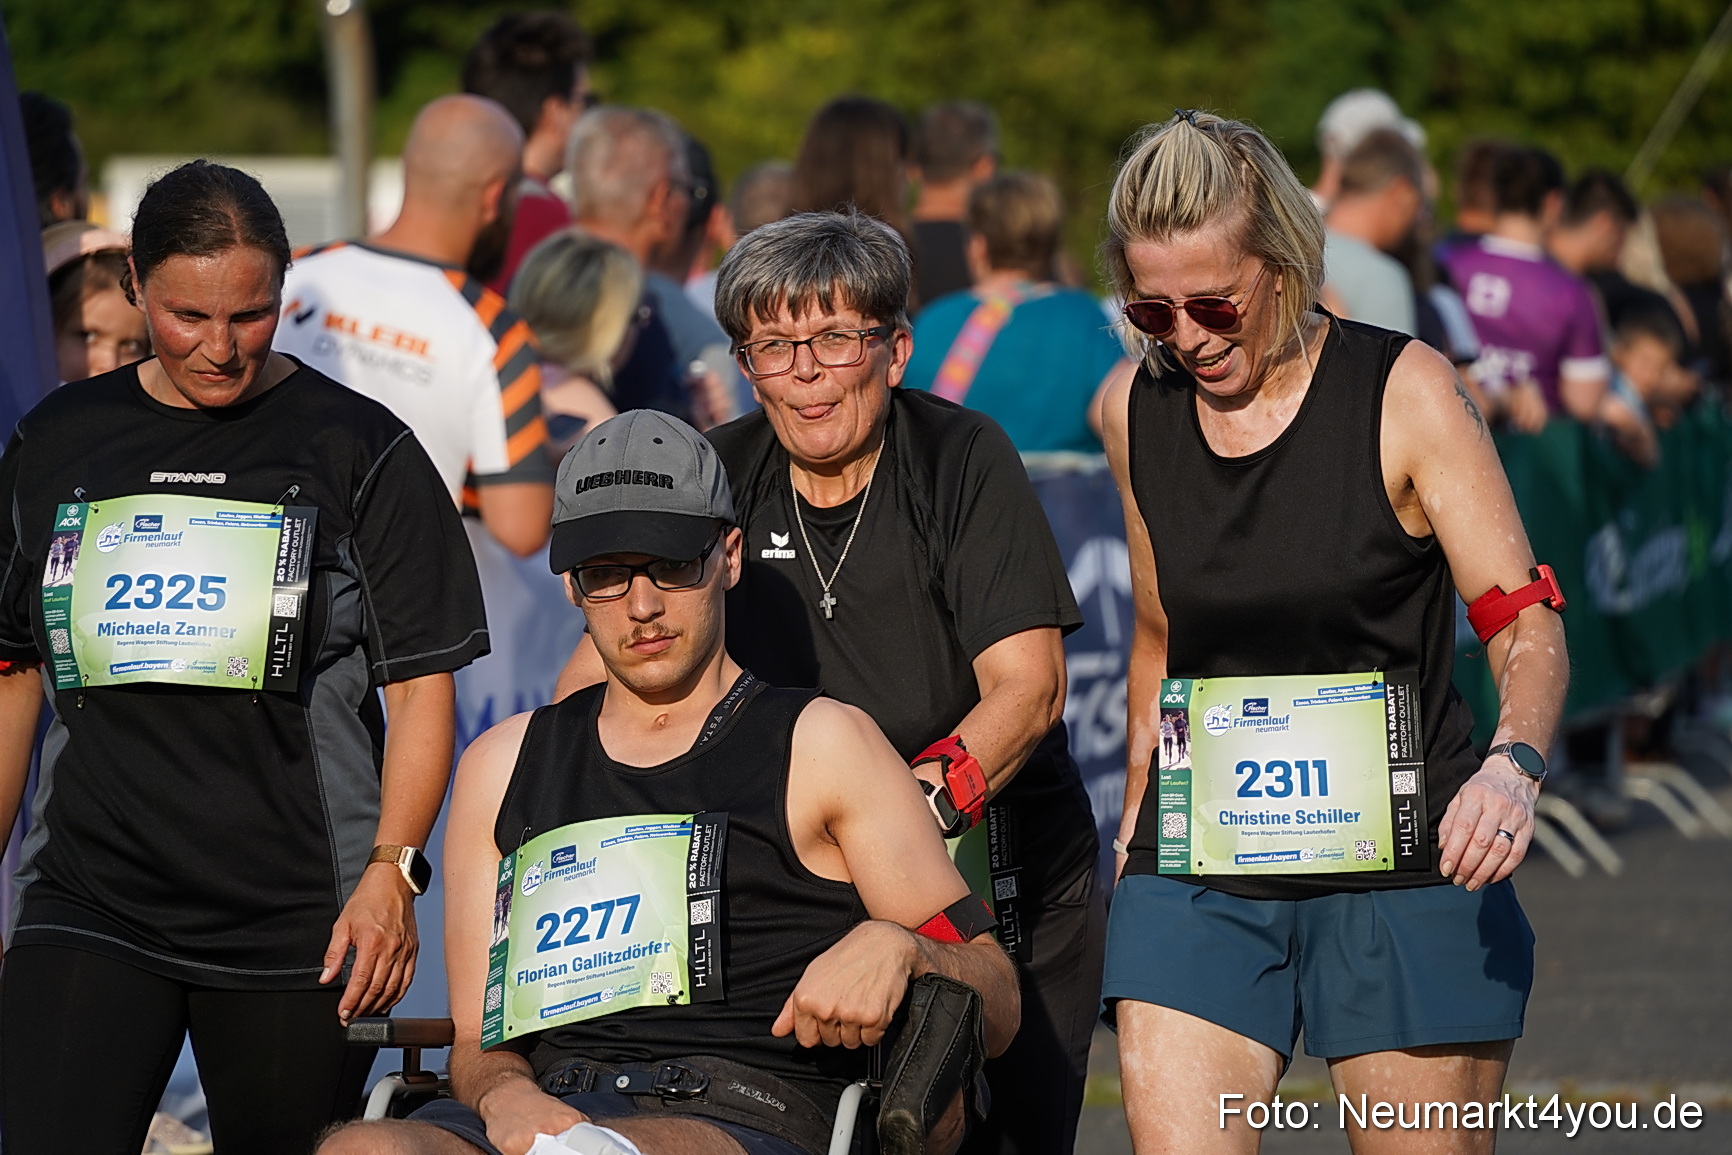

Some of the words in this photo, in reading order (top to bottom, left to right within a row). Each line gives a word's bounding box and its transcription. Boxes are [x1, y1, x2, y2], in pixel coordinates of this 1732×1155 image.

[150, 472, 226, 484] STANNO
[575, 469, 674, 495] LIEBHERR
[58, 516, 82, 527] AOK
[123, 531, 184, 543] Firmenlauf
[145, 540, 181, 548] neumarkt
[280, 516, 293, 557] RABATT
[287, 548, 297, 583] FACTORY
[292, 518, 302, 548] OUTLET
[761, 547, 796, 559] erima
[276, 567, 285, 582] 20
[104, 573, 227, 612] 2325
[97, 621, 171, 637] Michaela
[175, 621, 237, 639] Zanner
[271, 622, 289, 677] HILTL
[112, 662, 169, 674] firmenlauf.bayern
[1163, 693, 1186, 704] AOK
[1386, 684, 1397, 731] RABATT
[1397, 684, 1406, 719] OUTLET
[1233, 714, 1291, 728] Firmenlauf
[1255, 724, 1290, 733] neumarkt
[1389, 731, 1398, 741] %
[1400, 719, 1408, 758] FACTORY
[1390, 742, 1398, 759] 20
[1235, 759, 1329, 798] 2311
[989, 806, 997, 844] RABATT
[1219, 810, 1291, 826] Christine
[1295, 808, 1361, 825] Schiller
[1398, 800, 1413, 856] HILTL
[690, 824, 703, 862] RABATT
[702, 824, 712, 853] OUTLET
[1281, 829, 1303, 837] Stiftung
[1303, 828, 1336, 836] Lauterhofen
[991, 853, 999, 869] 20
[1000, 835, 1008, 866] FACTORY
[1237, 853, 1298, 864] firmenlauf.bayern
[498, 867, 514, 884] AOK
[543, 857, 598, 883] Firmenlauf
[563, 867, 597, 883] neumarkt
[689, 862, 697, 871] %
[699, 852, 709, 887] FACTORY
[688, 872, 697, 889] 20
[535, 893, 641, 953] 2277
[1002, 903, 1017, 953] HILTL
[517, 961, 568, 987] Florian
[572, 941, 671, 973] Gallitzdörfer
[694, 929, 707, 987] HILTL
[547, 979, 566, 989] Regens
[566, 976, 586, 986] Wagner
[585, 971, 606, 981] Stiftung
[606, 964, 635, 977] Lauterhofen
[542, 995, 599, 1017] firmenlauf.bayern
